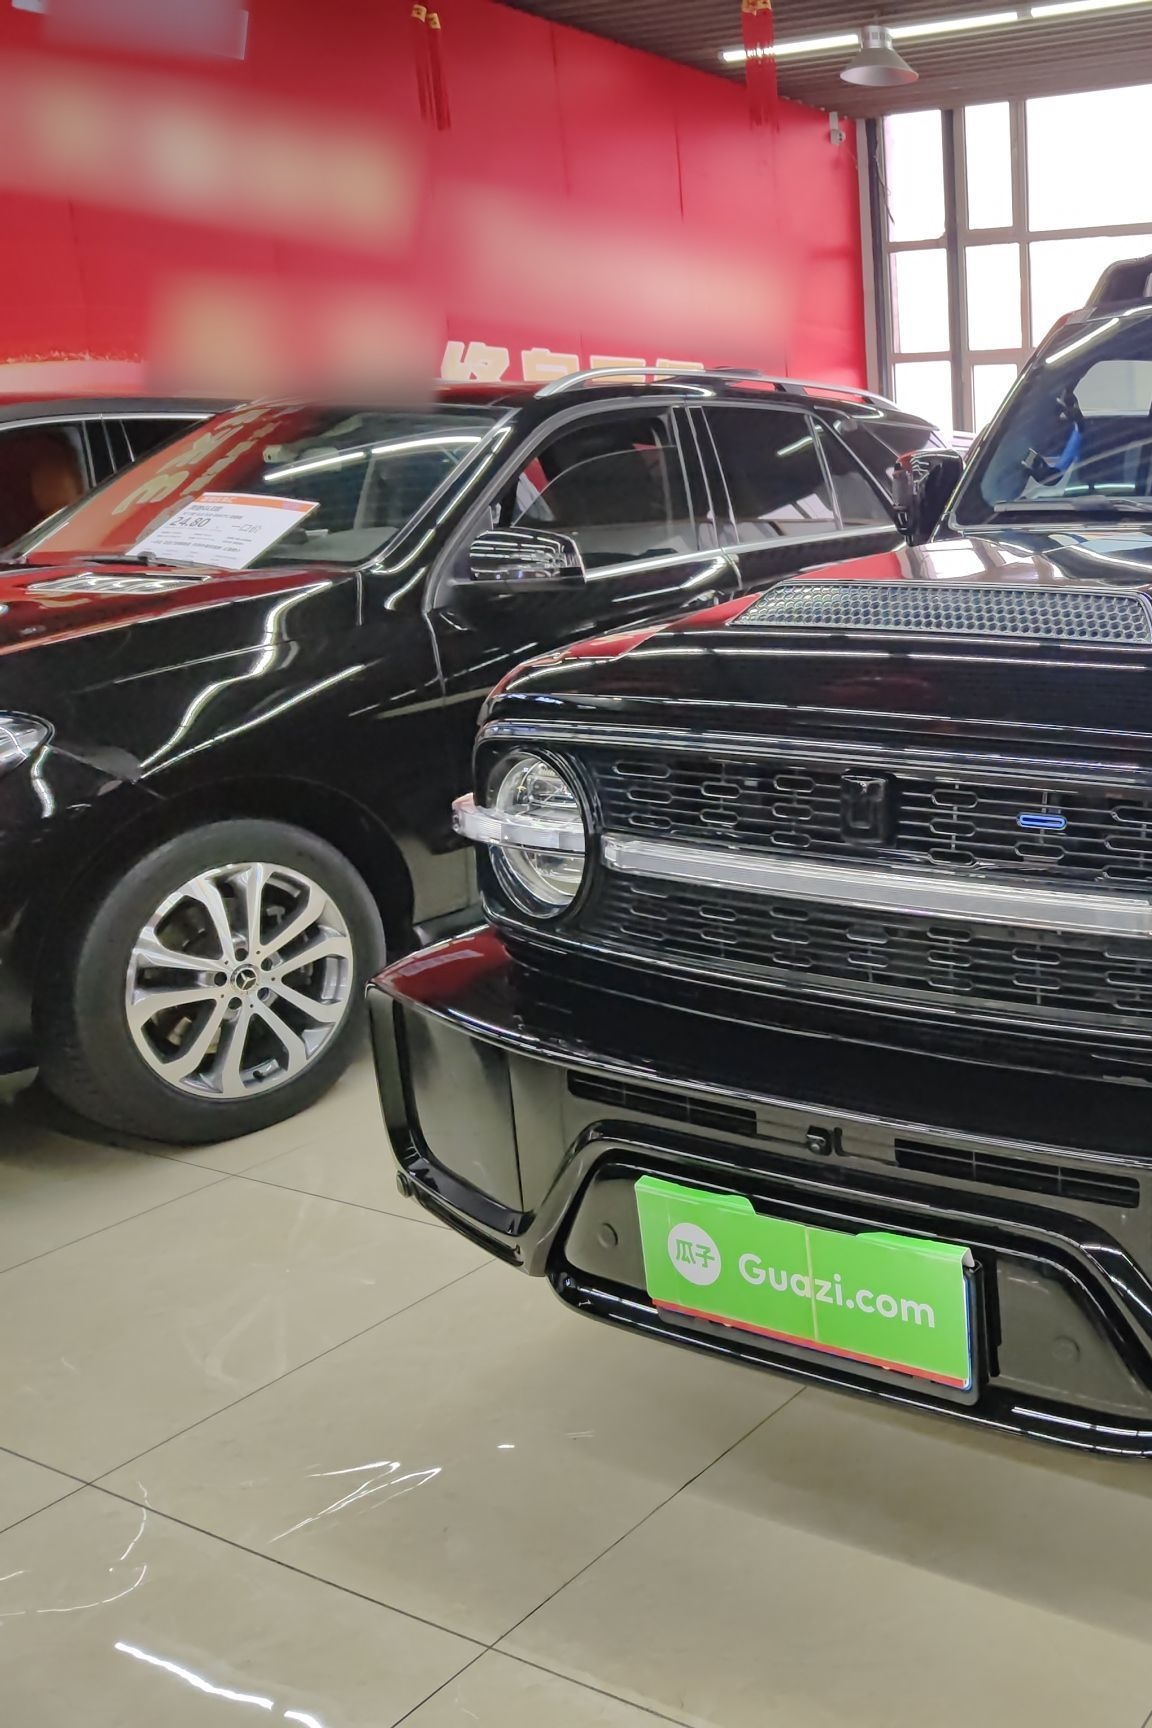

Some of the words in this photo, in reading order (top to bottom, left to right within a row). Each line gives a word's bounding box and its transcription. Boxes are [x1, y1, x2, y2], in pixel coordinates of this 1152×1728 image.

[169, 516, 210, 528] 24.80
[674, 1238, 716, 1269] 瓜子
[738, 1252, 936, 1329] Guazi.com
